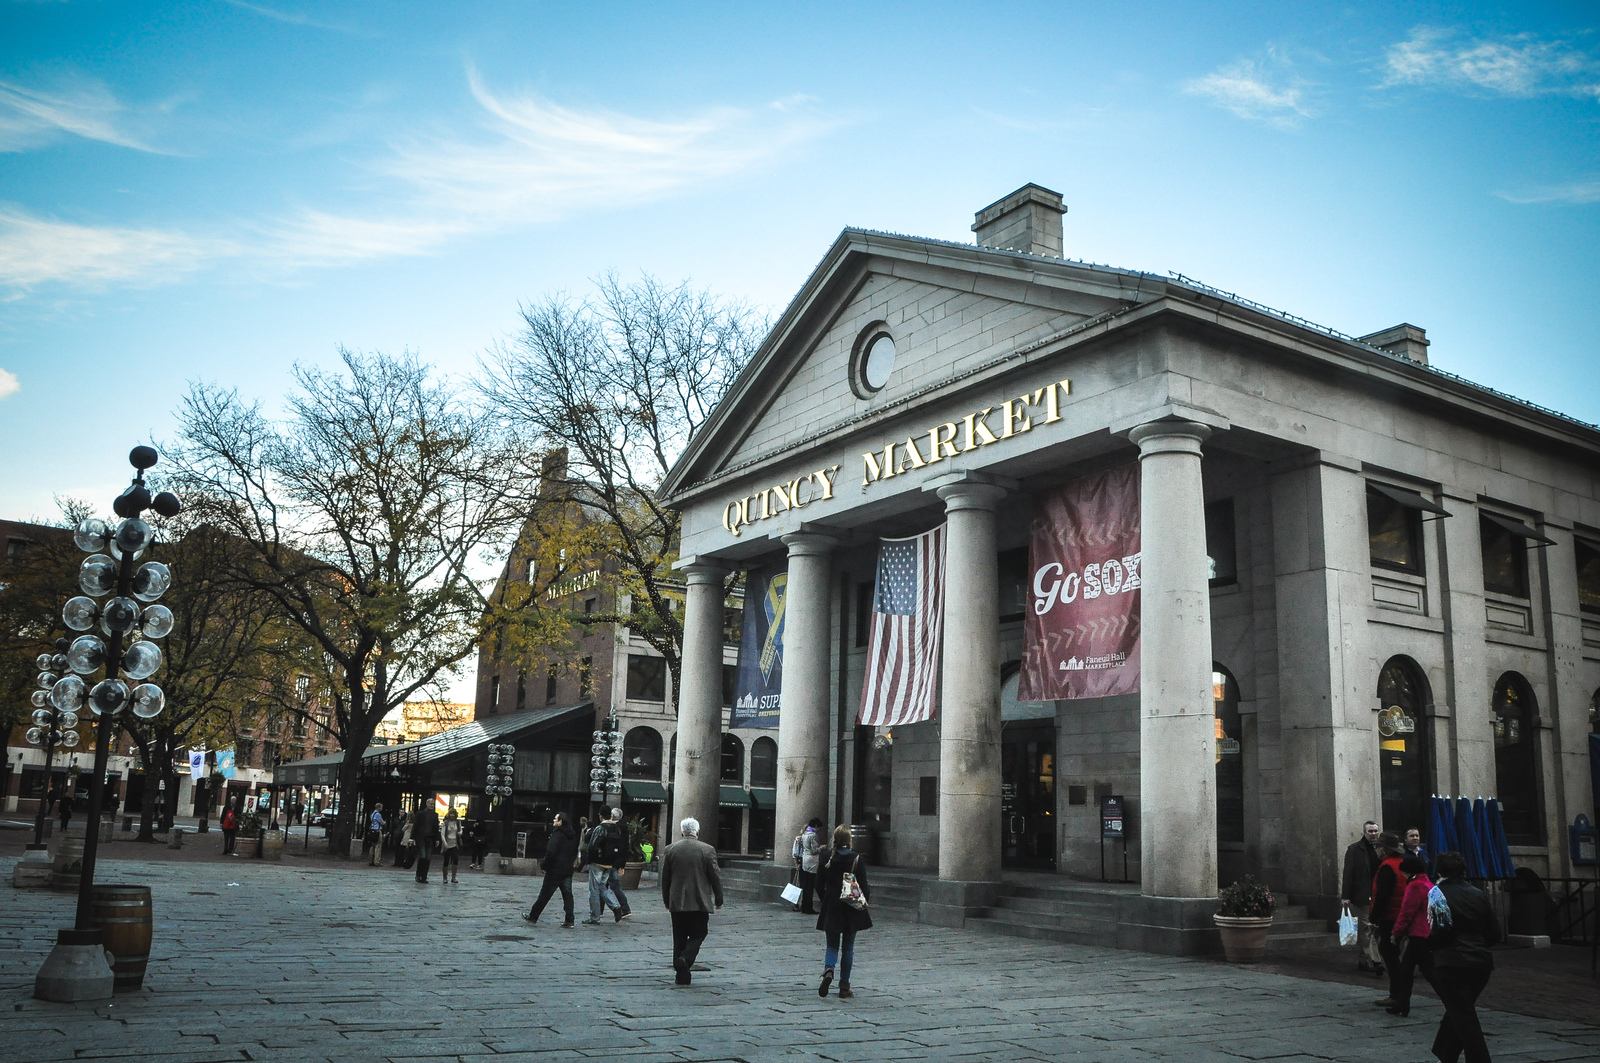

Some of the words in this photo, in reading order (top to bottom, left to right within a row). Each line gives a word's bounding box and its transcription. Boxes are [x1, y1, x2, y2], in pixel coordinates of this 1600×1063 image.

[722, 465, 839, 537] QUINCY
[861, 379, 1071, 487] MARKET
[1033, 562, 1082, 616] Go
[1083, 551, 1141, 599] SOX
[1085, 654, 1110, 664] Faneuil
[1111, 652, 1126, 661] Hall
[1085, 661, 1126, 670] MARKETPLACE
